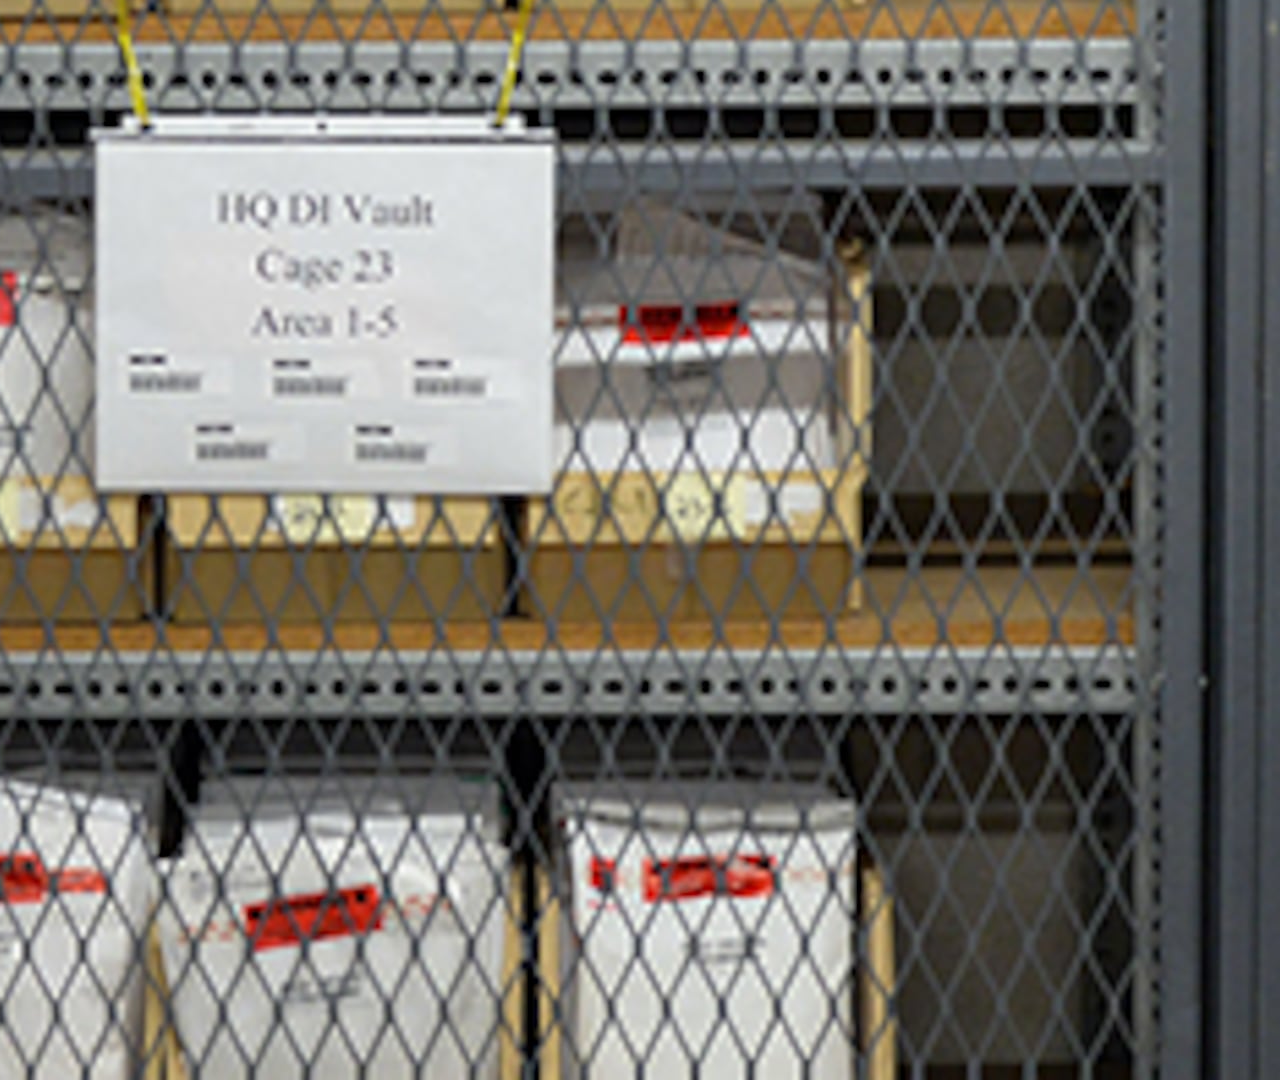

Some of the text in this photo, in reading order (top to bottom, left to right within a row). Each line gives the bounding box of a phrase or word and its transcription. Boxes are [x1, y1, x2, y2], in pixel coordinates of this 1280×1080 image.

[218, 191, 433, 229] HQ DI Vault
[256, 248, 393, 289] Cage 23
[251, 305, 398, 338] Area 1-5
